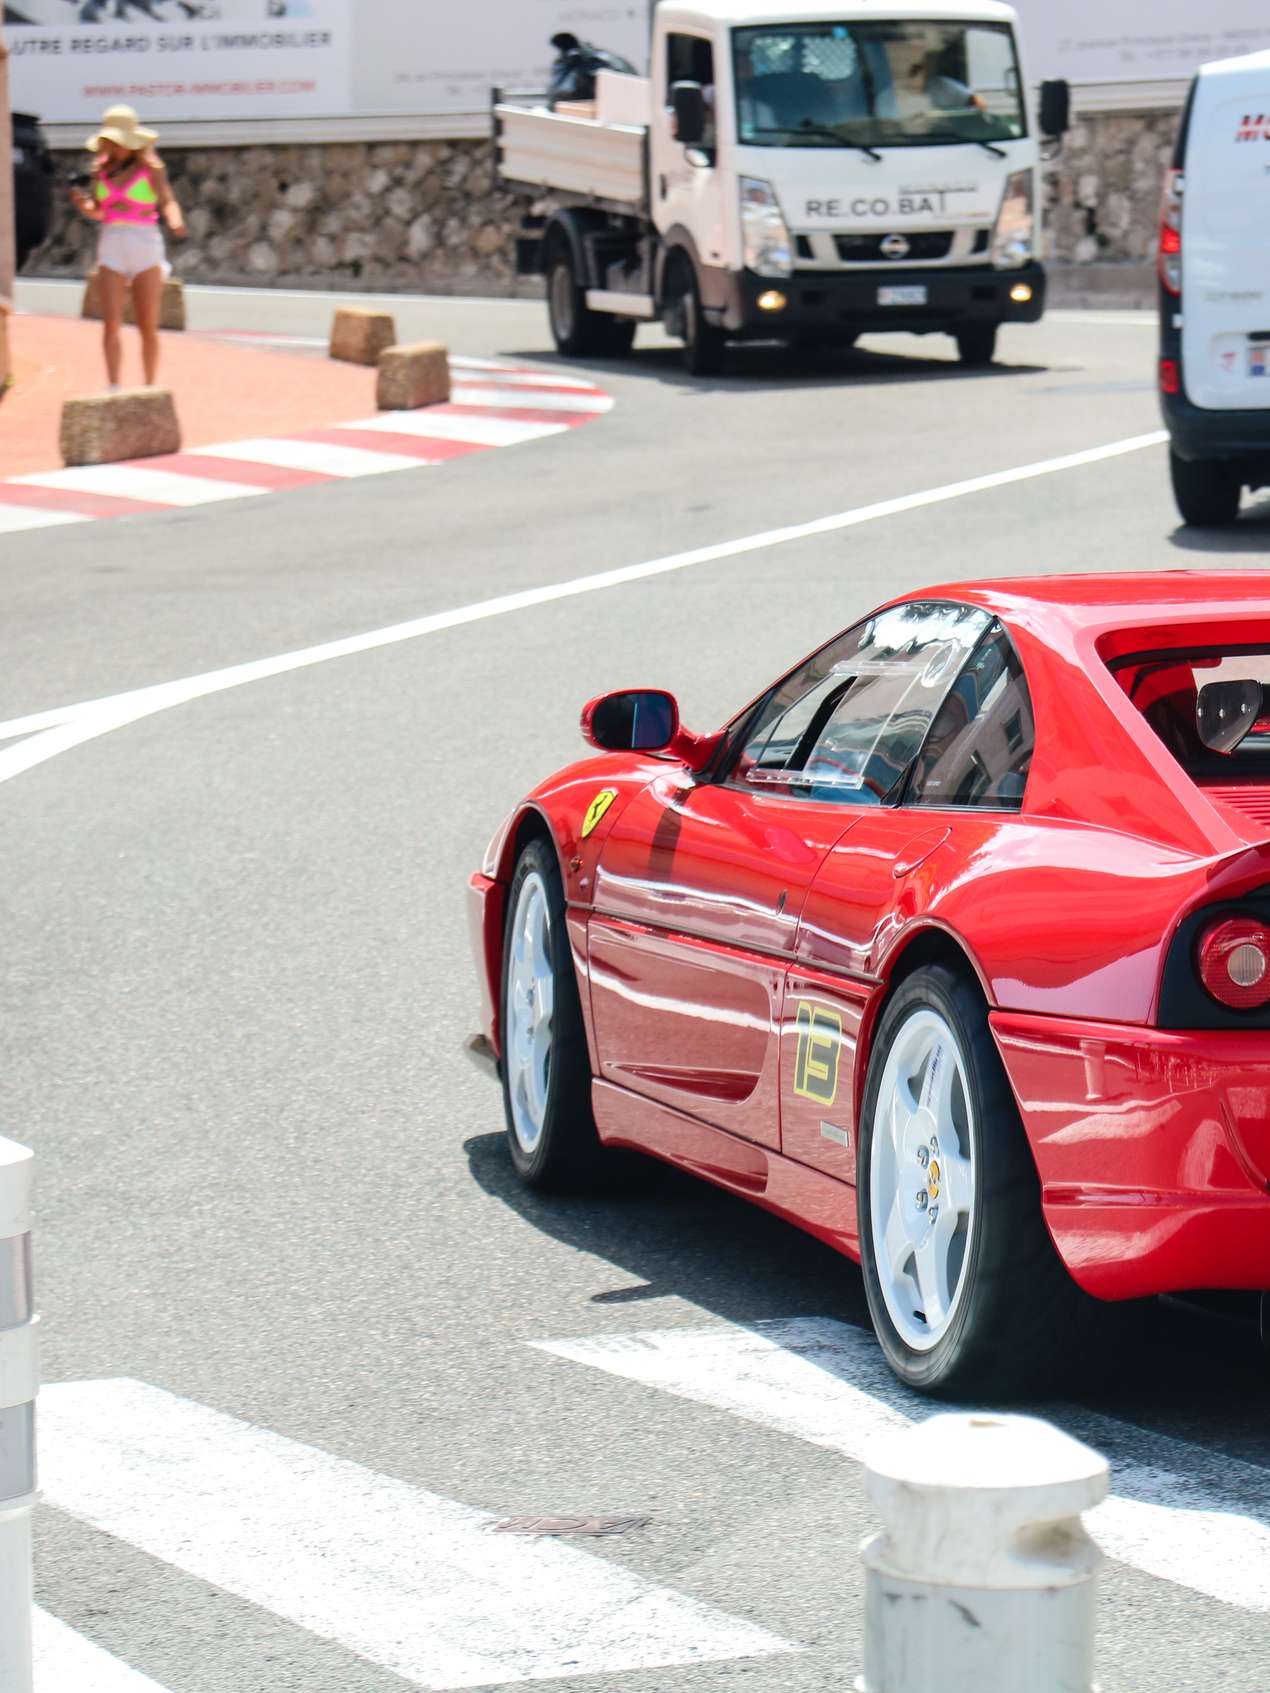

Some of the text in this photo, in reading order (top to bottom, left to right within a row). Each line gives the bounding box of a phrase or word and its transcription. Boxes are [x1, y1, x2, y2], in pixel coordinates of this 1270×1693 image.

[70, 35, 150, 53] REGARD
[157, 34, 193, 51] SUR
[202, 31, 331, 50] L'IMMOBILIER
[794, 1000, 842, 1106] 13
